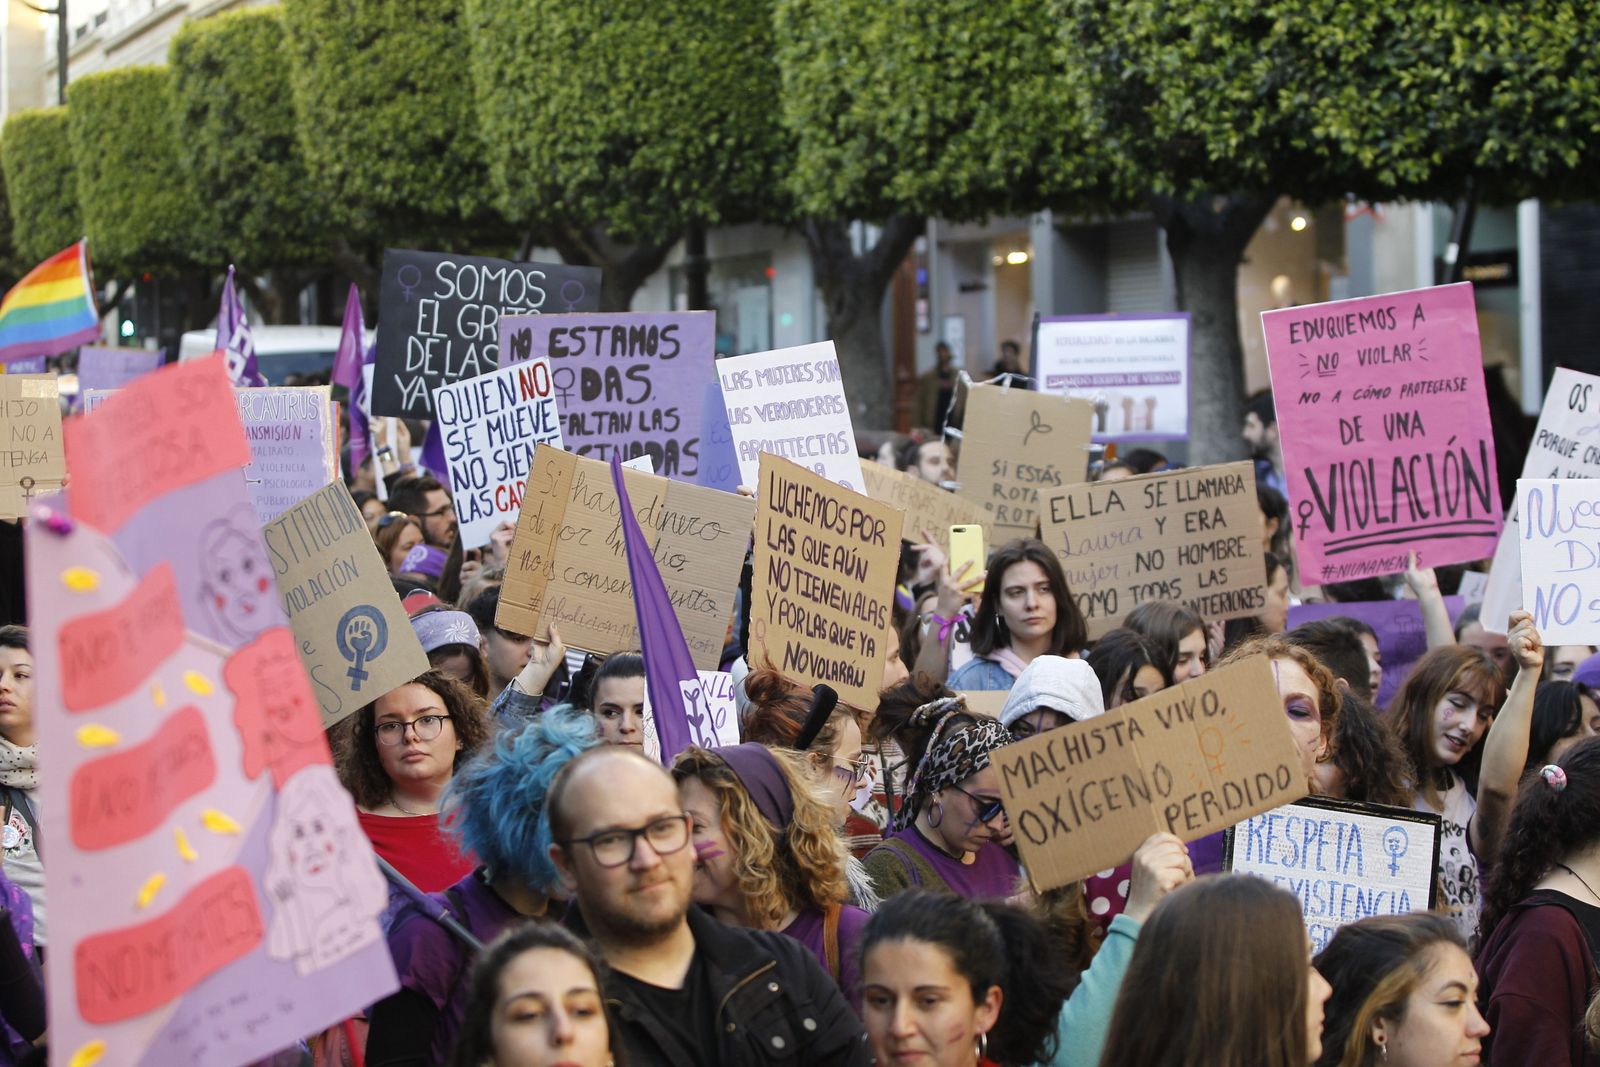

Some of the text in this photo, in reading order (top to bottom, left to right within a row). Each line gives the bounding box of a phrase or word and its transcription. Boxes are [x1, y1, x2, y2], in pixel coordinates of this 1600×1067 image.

[434, 261, 546, 307] SOMOS
[417, 299, 448, 338] EL
[1289, 303, 1426, 344] EDUQUEMOS A
[510, 324, 681, 361] NO ESTAMOS
[1317, 343, 1412, 371] NO VIOLAR
[395, 374, 431, 413] YA
[437, 361, 550, 426] QUIEN NO
[722, 359, 842, 392] LAS MUJERES SON
[1298, 376, 1469, 405] NO A CÓMO PROTEGERSE
[447, 398, 558, 462] SE MUEVE
[639, 407, 680, 432] LAS
[728, 395, 845, 426] LAS VERDADERAS
[1339, 410, 1425, 445] DE UNA
[12, 424, 54, 443] NO A
[739, 430, 850, 462] ARQUITECTAS
[1536, 429, 1580, 458] PORQUE
[0, 449, 48, 468] TENGA
[259, 463, 306, 473] VIOLENCIA
[451, 434, 560, 493] NO SIEN
[1016, 464, 1062, 487] ESTÁS
[539, 460, 731, 546] Si hay dinero
[1050, 474, 1247, 524] ELLA SE LLAMABA
[1304, 435, 1492, 533] VIOLACIÓN
[456, 489, 494, 524] LAS
[769, 470, 846, 536] LUCHEMOS
[849, 508, 886, 547] POR
[528, 501, 546, 535] de
[546, 524, 592, 562] por
[767, 517, 868, 583] LAS QUE AÚN
[1058, 507, 1227, 559] Laura Y ERA
[519, 549, 542, 572] no
[1135, 549, 1165, 574] NO
[1198, 568, 1229, 589] LAS
[1321, 552, 1422, 579] #NIUNAMENS
[282, 555, 360, 618] VIOLACIÓN
[768, 555, 887, 630] NO TIENEN ALAS
[1182, 585, 1266, 616] NTERIORES
[766, 589, 875, 658] Y POR LAS QUE YA
[1534, 583, 1582, 631] NO
[783, 640, 866, 688] NO VOLARÁN
[1002, 717, 1145, 799] MACHISTA
[1018, 759, 1292, 847] OXÍGENO PERDIDO
[1246, 813, 1364, 877] RESPETA
